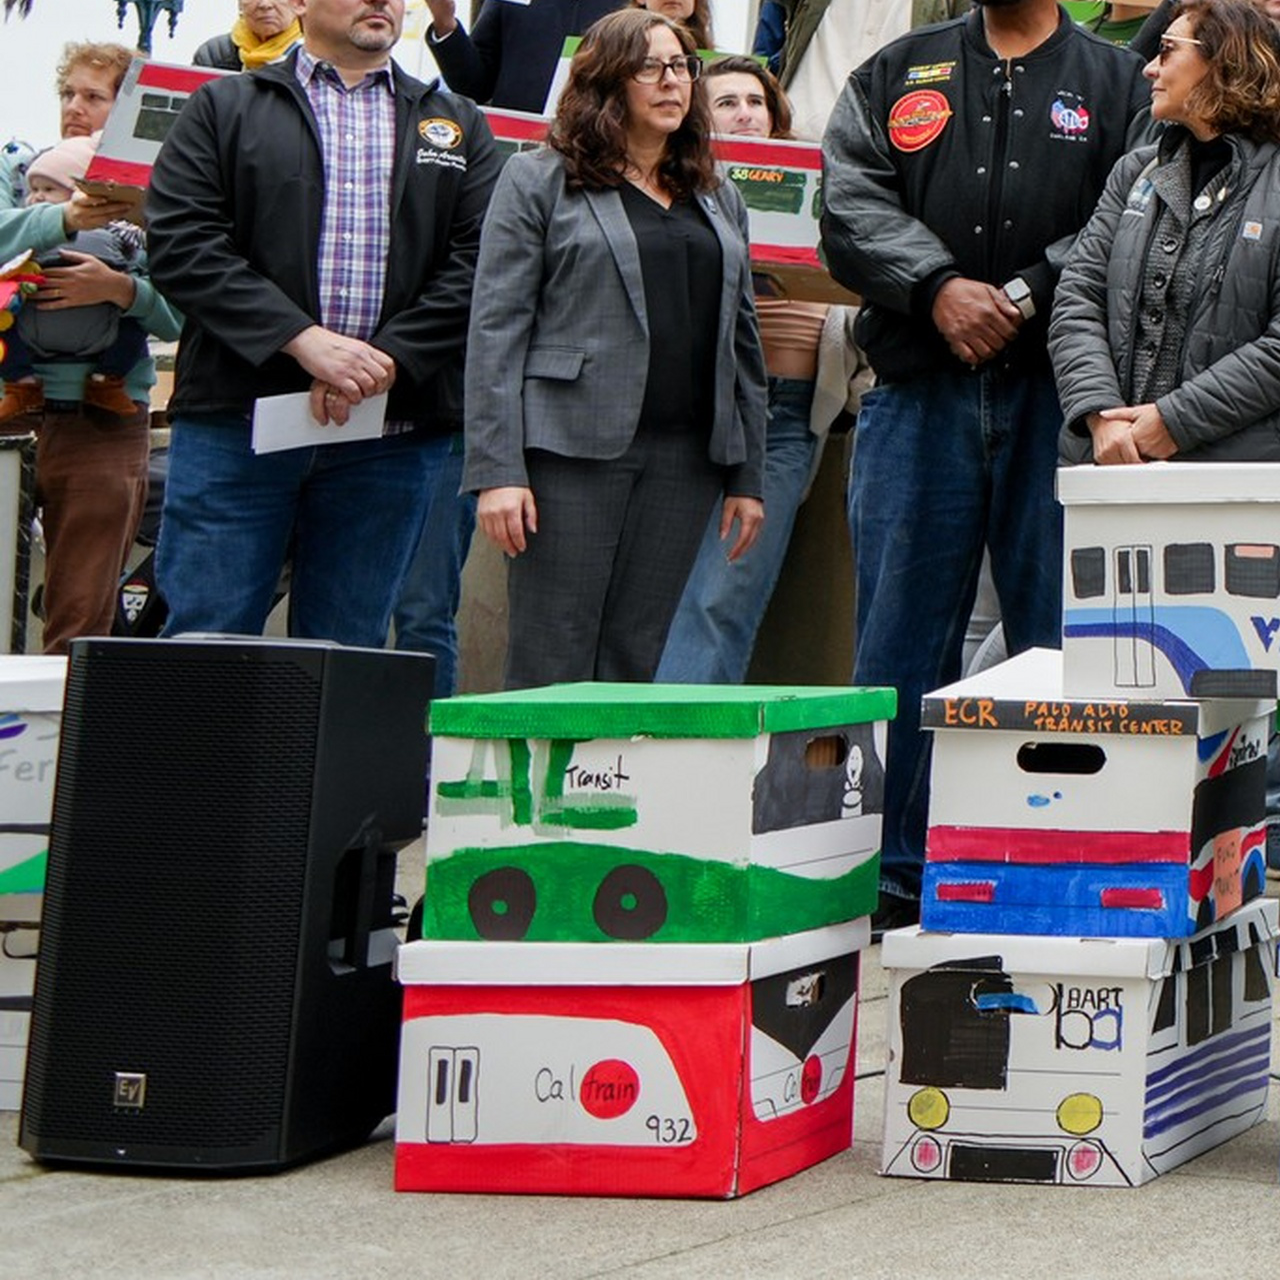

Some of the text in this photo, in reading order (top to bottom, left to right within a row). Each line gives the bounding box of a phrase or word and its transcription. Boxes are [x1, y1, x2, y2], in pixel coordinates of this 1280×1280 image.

[731, 168, 749, 181] 38
[943, 698, 1129, 728] ECR PALO ALTO
[1033, 716, 1184, 736] TRANSIT CENTER
[564, 754, 630, 790] Transit
[1066, 986, 1124, 1011] BART
[118, 1079, 141, 1101] EV
[645, 1114, 694, 1144] 932
